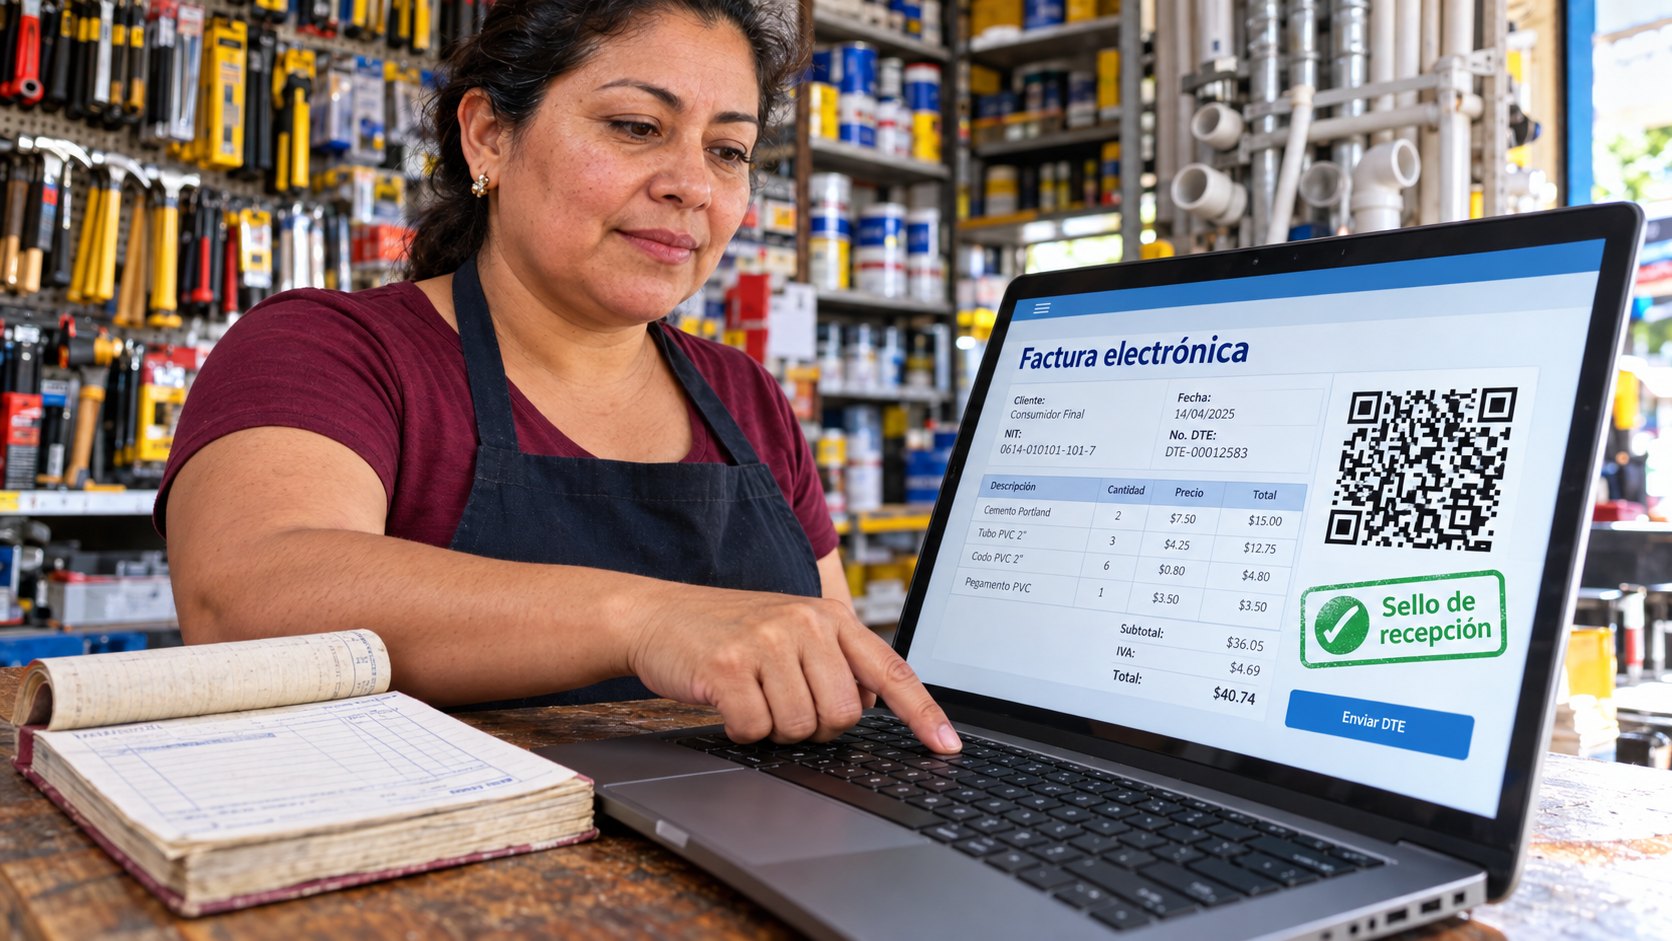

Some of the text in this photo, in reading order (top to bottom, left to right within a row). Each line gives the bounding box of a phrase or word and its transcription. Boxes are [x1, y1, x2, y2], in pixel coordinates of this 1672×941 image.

[1019, 335, 1249, 369] Factura electrónica
[1013, 395, 1046, 406] Cliente:
[1177, 391, 1212, 403] Fecha:
[1010, 408, 1086, 421] Consumidor Final
[1174, 408, 1236, 421] 14/04/2025
[1004, 429, 1022, 439] NIT:
[1168, 429, 1217, 441] No. DTE:
[999, 443, 1097, 456] 0614-010101-101-7
[1164, 445, 1249, 459] DTE-00012583
[990, 480, 1037, 493] Descripción
[1107, 484, 1146, 496] Cantidad
[1174, 487, 1205, 498] Precio
[1253, 489, 1278, 501] Total
[983, 504, 1052, 518] Cemento Portland
[1114, 510, 1122, 521] 2
[1169, 512, 1197, 525] $7.50
[1248, 514, 1283, 527] $15.00
[978, 527, 997, 539] Tubo
[997, 528, 1016, 540] PVC
[1109, 535, 1116, 546] 3
[1163, 538, 1191, 551] $4.25
[1243, 541, 1277, 555] $12.75
[971, 551, 993, 562] Codo
[993, 552, 1012, 564] PVC
[1103, 560, 1111, 571] 6
[1158, 563, 1186, 577] $0.80
[1241, 569, 1271, 582] $4.80
[964, 576, 1032, 594] Pegamento PVC
[1151, 591, 1180, 605] $3.50
[1383, 591, 1475, 617] Sello de
[1238, 598, 1268, 613] $3.50
[1119, 623, 1164, 639] Subtotal:
[1381, 617, 1491, 647] recepción
[1226, 635, 1264, 652] $36.05
[1116, 645, 1136, 659] IVA:
[1229, 660, 1261, 677] $4.69
[1112, 669, 1143, 685] Total:
[1212, 685, 1256, 706] $40.74
[1341, 710, 1407, 734] Enviar DTE
